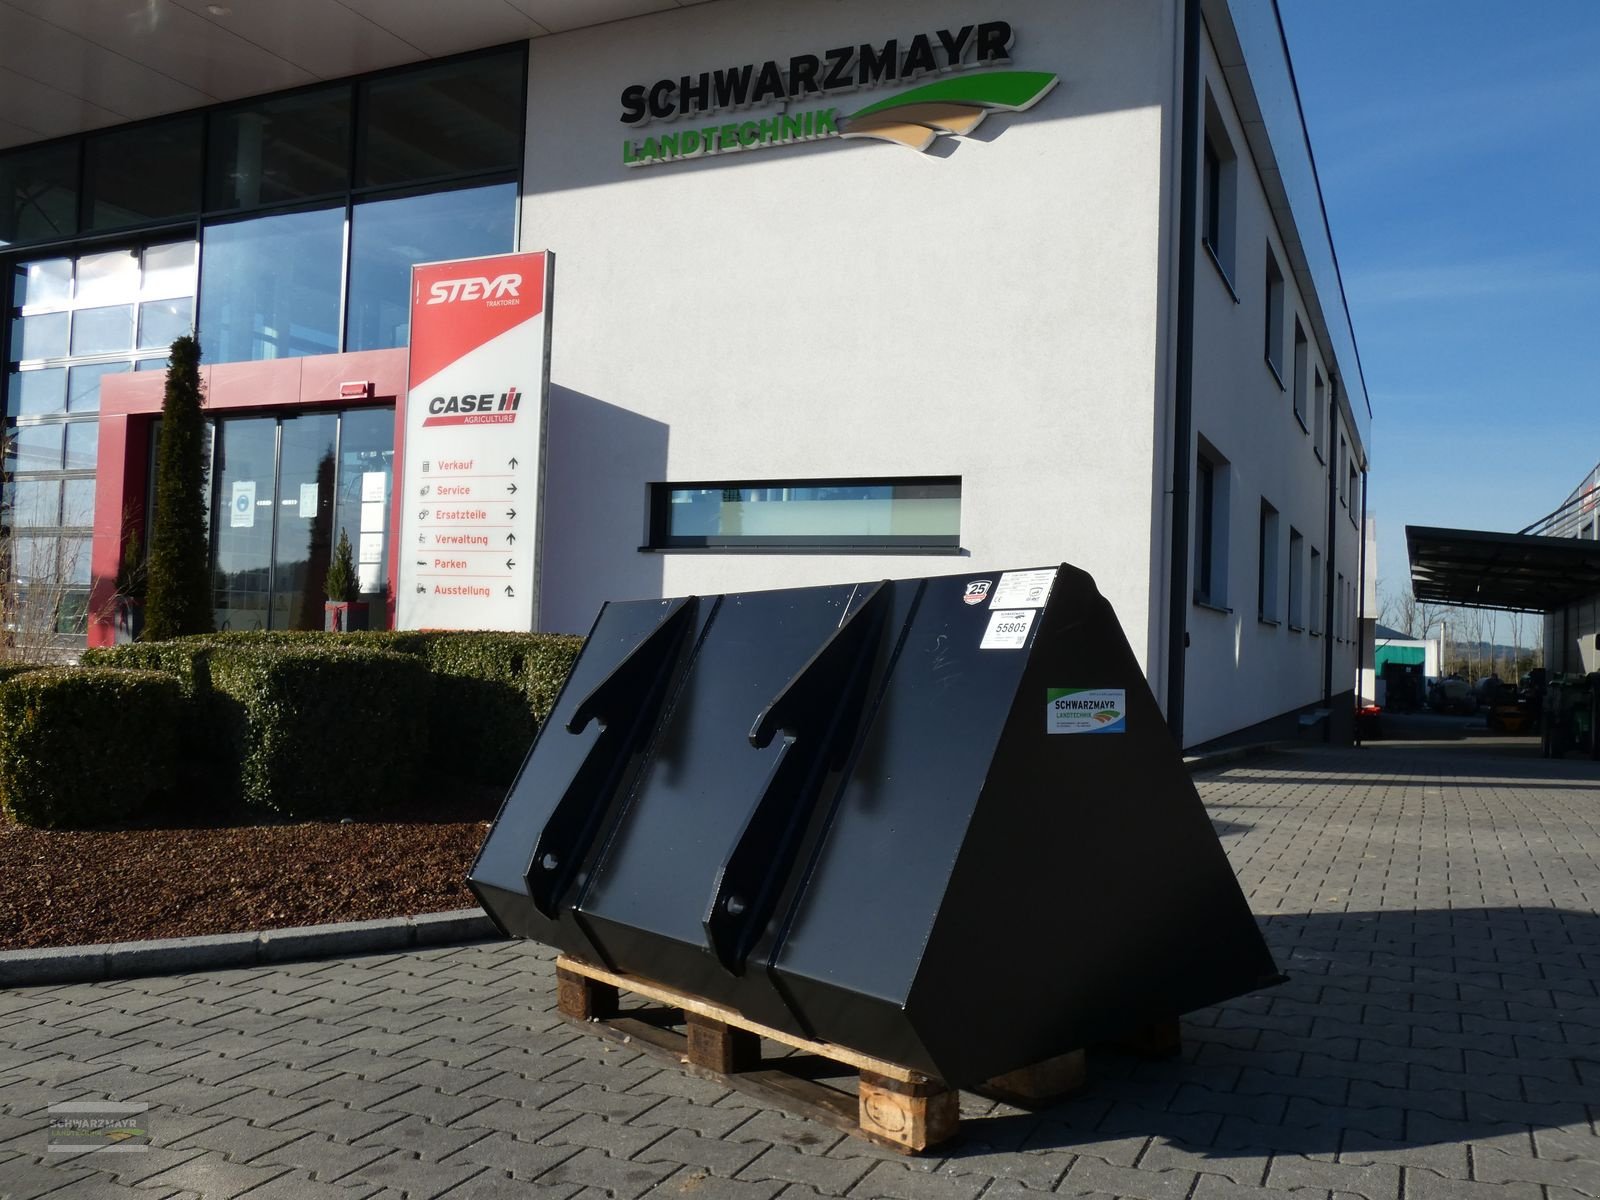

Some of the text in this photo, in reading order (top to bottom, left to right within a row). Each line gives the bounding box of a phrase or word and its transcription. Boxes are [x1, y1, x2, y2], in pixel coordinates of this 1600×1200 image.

[620, 20, 1013, 124] SCHWARZMAYR
[623, 107, 838, 166] LANDTECHNIK
[427, 273, 522, 305] STEYR
[486, 298, 520, 308] TRAKTOREN
[428, 393, 494, 415] CASE
[464, 414, 513, 424] AGRICULTURE
[438, 459, 474, 470] Verkauf
[437, 485, 470, 496] Service
[436, 509, 487, 520] Ersatzteile
[435, 534, 488, 546] Verwaltung
[434, 558, 467, 569] Parken
[434, 584, 490, 597] Ausstellung
[969, 584, 986, 595] 25
[995, 622, 1027, 633] 55805
[1055, 700, 1115, 710] SCHWARZMAYR
